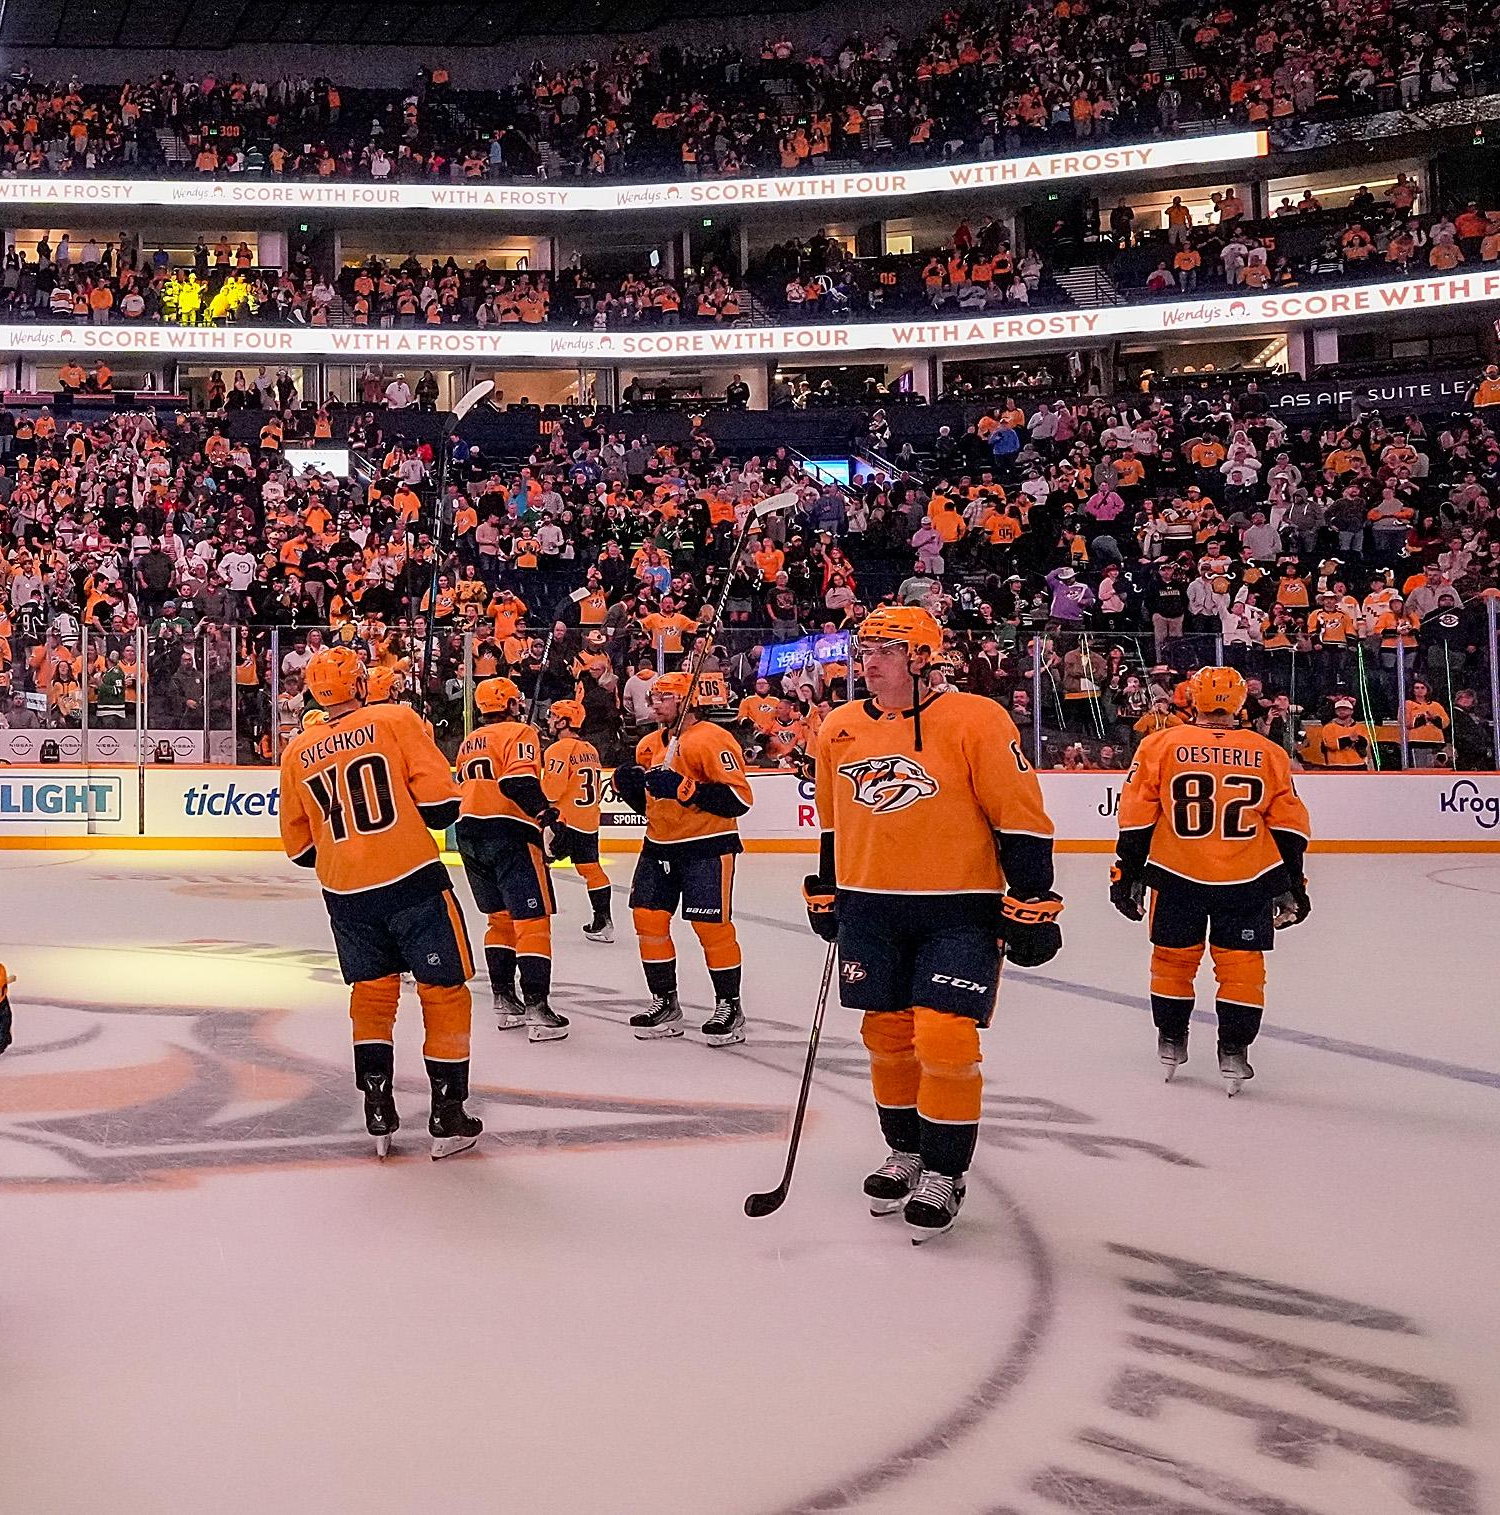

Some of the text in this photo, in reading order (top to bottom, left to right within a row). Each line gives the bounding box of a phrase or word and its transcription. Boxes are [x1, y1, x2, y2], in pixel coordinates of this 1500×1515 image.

[949, 148, 1152, 186] WITH A FROSTY
[47, 186, 58, 198] A
[65, 186, 132, 198] FROSTY
[233, 187, 292, 201] SCORE
[300, 188, 346, 202] WITH
[353, 189, 399, 203] FOUR
[431, 191, 568, 205] WITH A FROSTY
[691, 184, 767, 202] SCORE
[775, 179, 835, 198] WITH
[844, 176, 906, 194] FOUR
[1261, 291, 1369, 318] SCORE
[1379, 279, 1469, 307] WITH
[84, 331, 160, 347] SCORE
[167, 332, 225, 348] WITH
[234, 333, 292, 349] FOUR
[892, 314, 1099, 344] WITH A FROSTY
[331, 334, 501, 351] WITH A FROSTY
[623, 336, 703, 353] SCORE
[710, 332, 773, 351] WITH
[784, 330, 848, 348] FOUR
[1368, 384, 1431, 405] SUITE
[299, 724, 375, 769] SVECHKOV
[517, 741, 535, 762] 19
[1176, 746, 1263, 769] OESTERLE
[548, 758, 565, 774] 37
[719, 749, 741, 772] 91
[0, 784, 113, 814] LIGHT
[183, 783, 280, 817] ticket
[302, 753, 398, 843] 40
[1169, 770, 1265, 841] 82
[613, 814, 648, 825] SPORTS
[685, 906, 721, 915] BAUER
[1001, 901, 1060, 924] CCM
[931, 972, 988, 994] CCM
